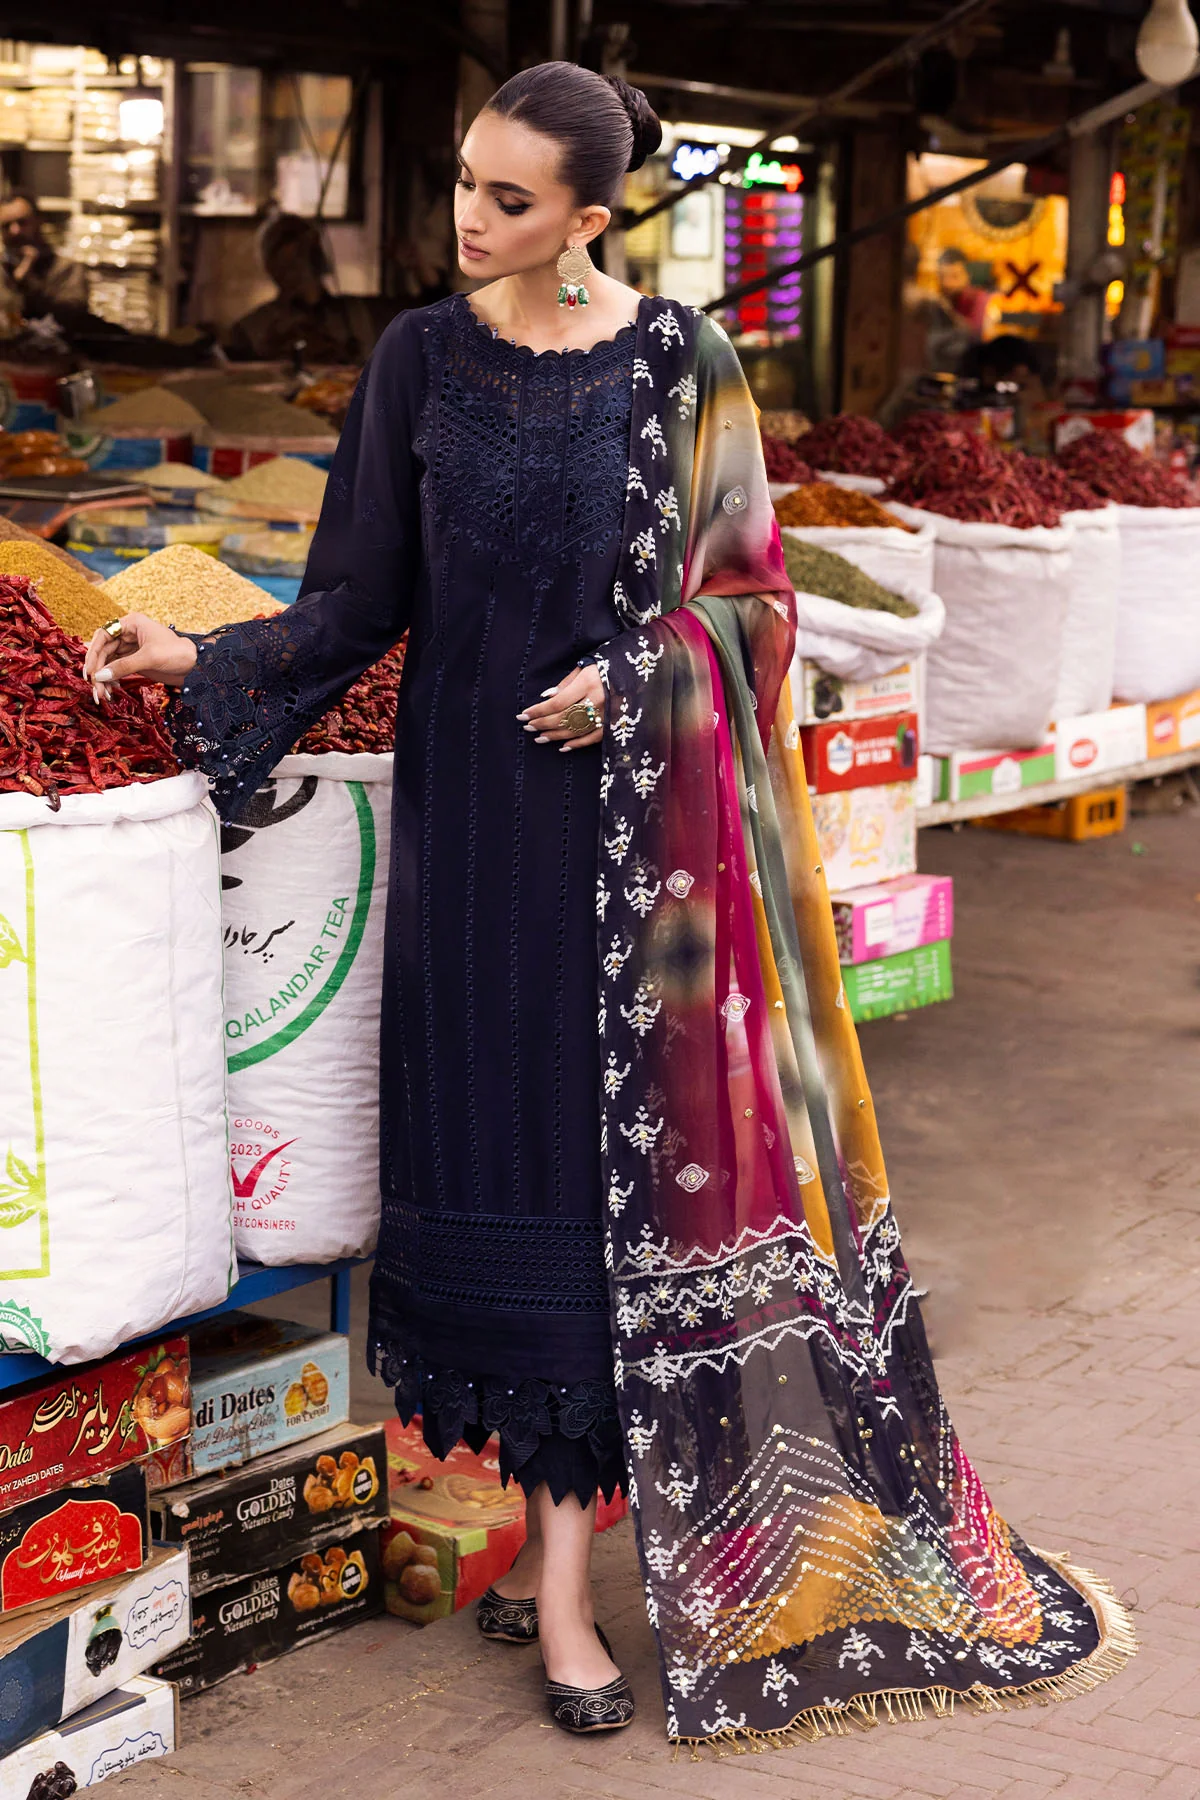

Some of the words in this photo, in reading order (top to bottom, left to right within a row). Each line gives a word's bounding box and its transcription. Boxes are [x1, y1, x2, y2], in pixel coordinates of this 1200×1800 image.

[225, 944, 330, 1039] QALANDAR
[320, 896, 350, 939] TEA
[234, 1119, 280, 1140] GOODS
[230, 1143, 262, 1156] 2023
[232, 1202, 246, 1212] H
[251, 1159, 291, 1211] QUALITY
[220, 1384, 276, 1421] Dates
[286, 1415, 302, 1428] FOR
[0, 1440, 34, 1473] Dates
[12, 1473, 40, 1490] ZAHEDI
[40, 1463, 64, 1480] DATES
[270, 1476, 295, 1492] Dates
[237, 1487, 297, 1521] GOLDEN
[272, 1506, 295, 1522] Candy
[253, 1575, 279, 1593] Dates
[219, 1587, 281, 1625] GOLDEN
[138, 1740, 157, 1756] تحفه
[98, 1751, 136, 1778] بلوچستان
